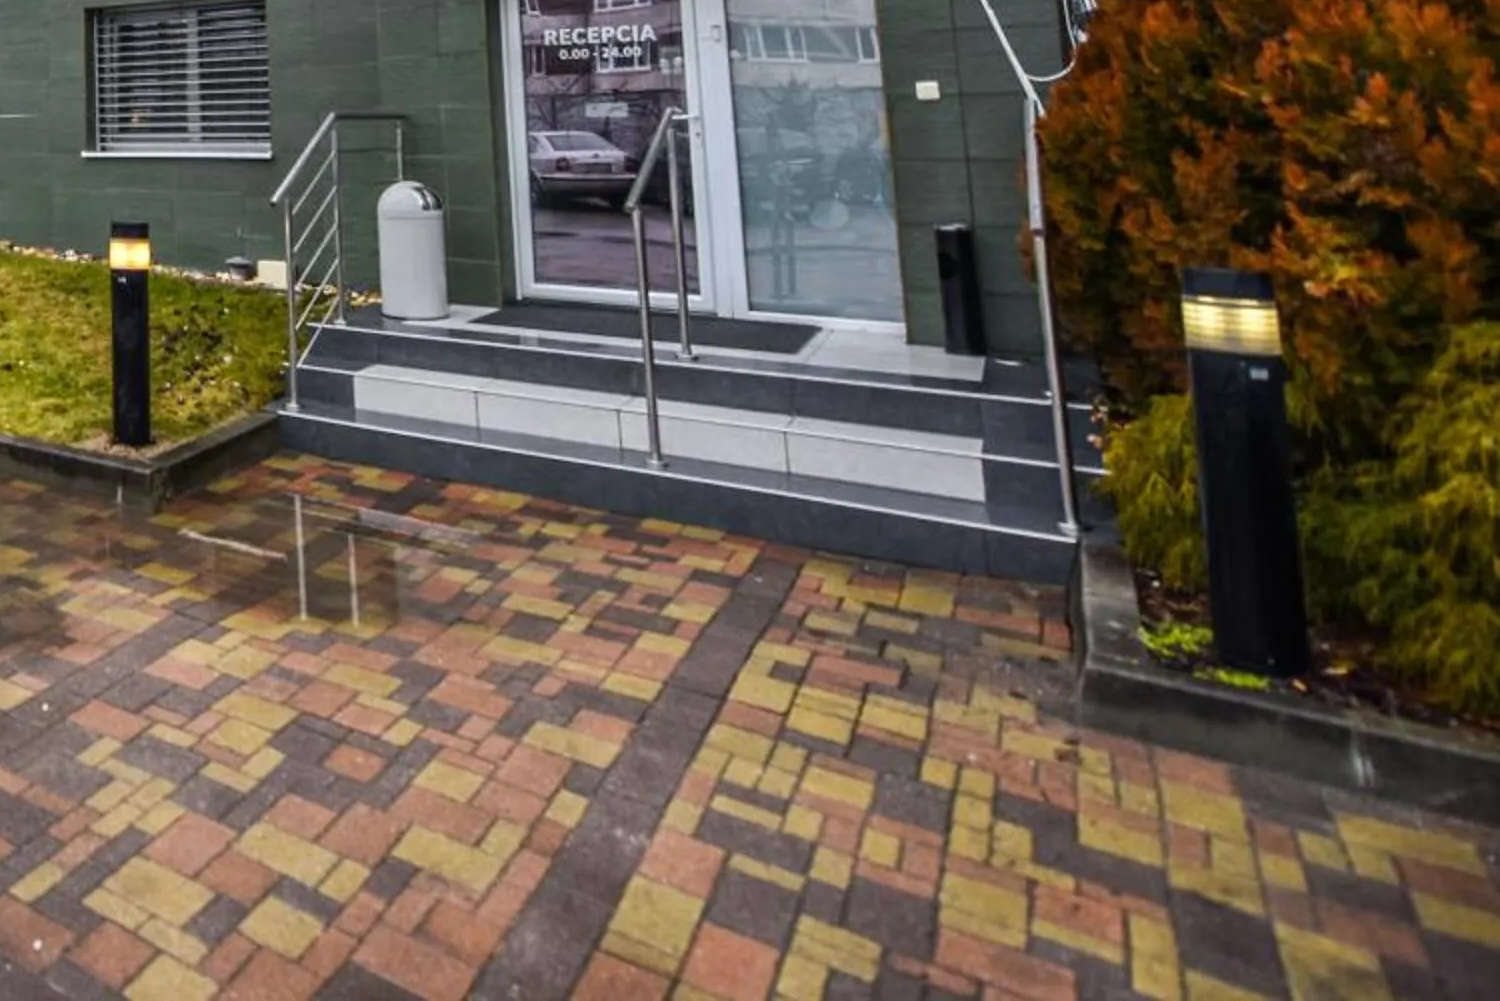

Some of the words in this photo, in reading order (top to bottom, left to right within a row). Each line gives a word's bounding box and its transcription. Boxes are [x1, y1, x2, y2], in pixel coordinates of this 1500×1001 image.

[543, 23, 657, 46] RECEPCIA
[558, 48, 589, 60] 0.00
[600, 45, 642, 59] 24.00
